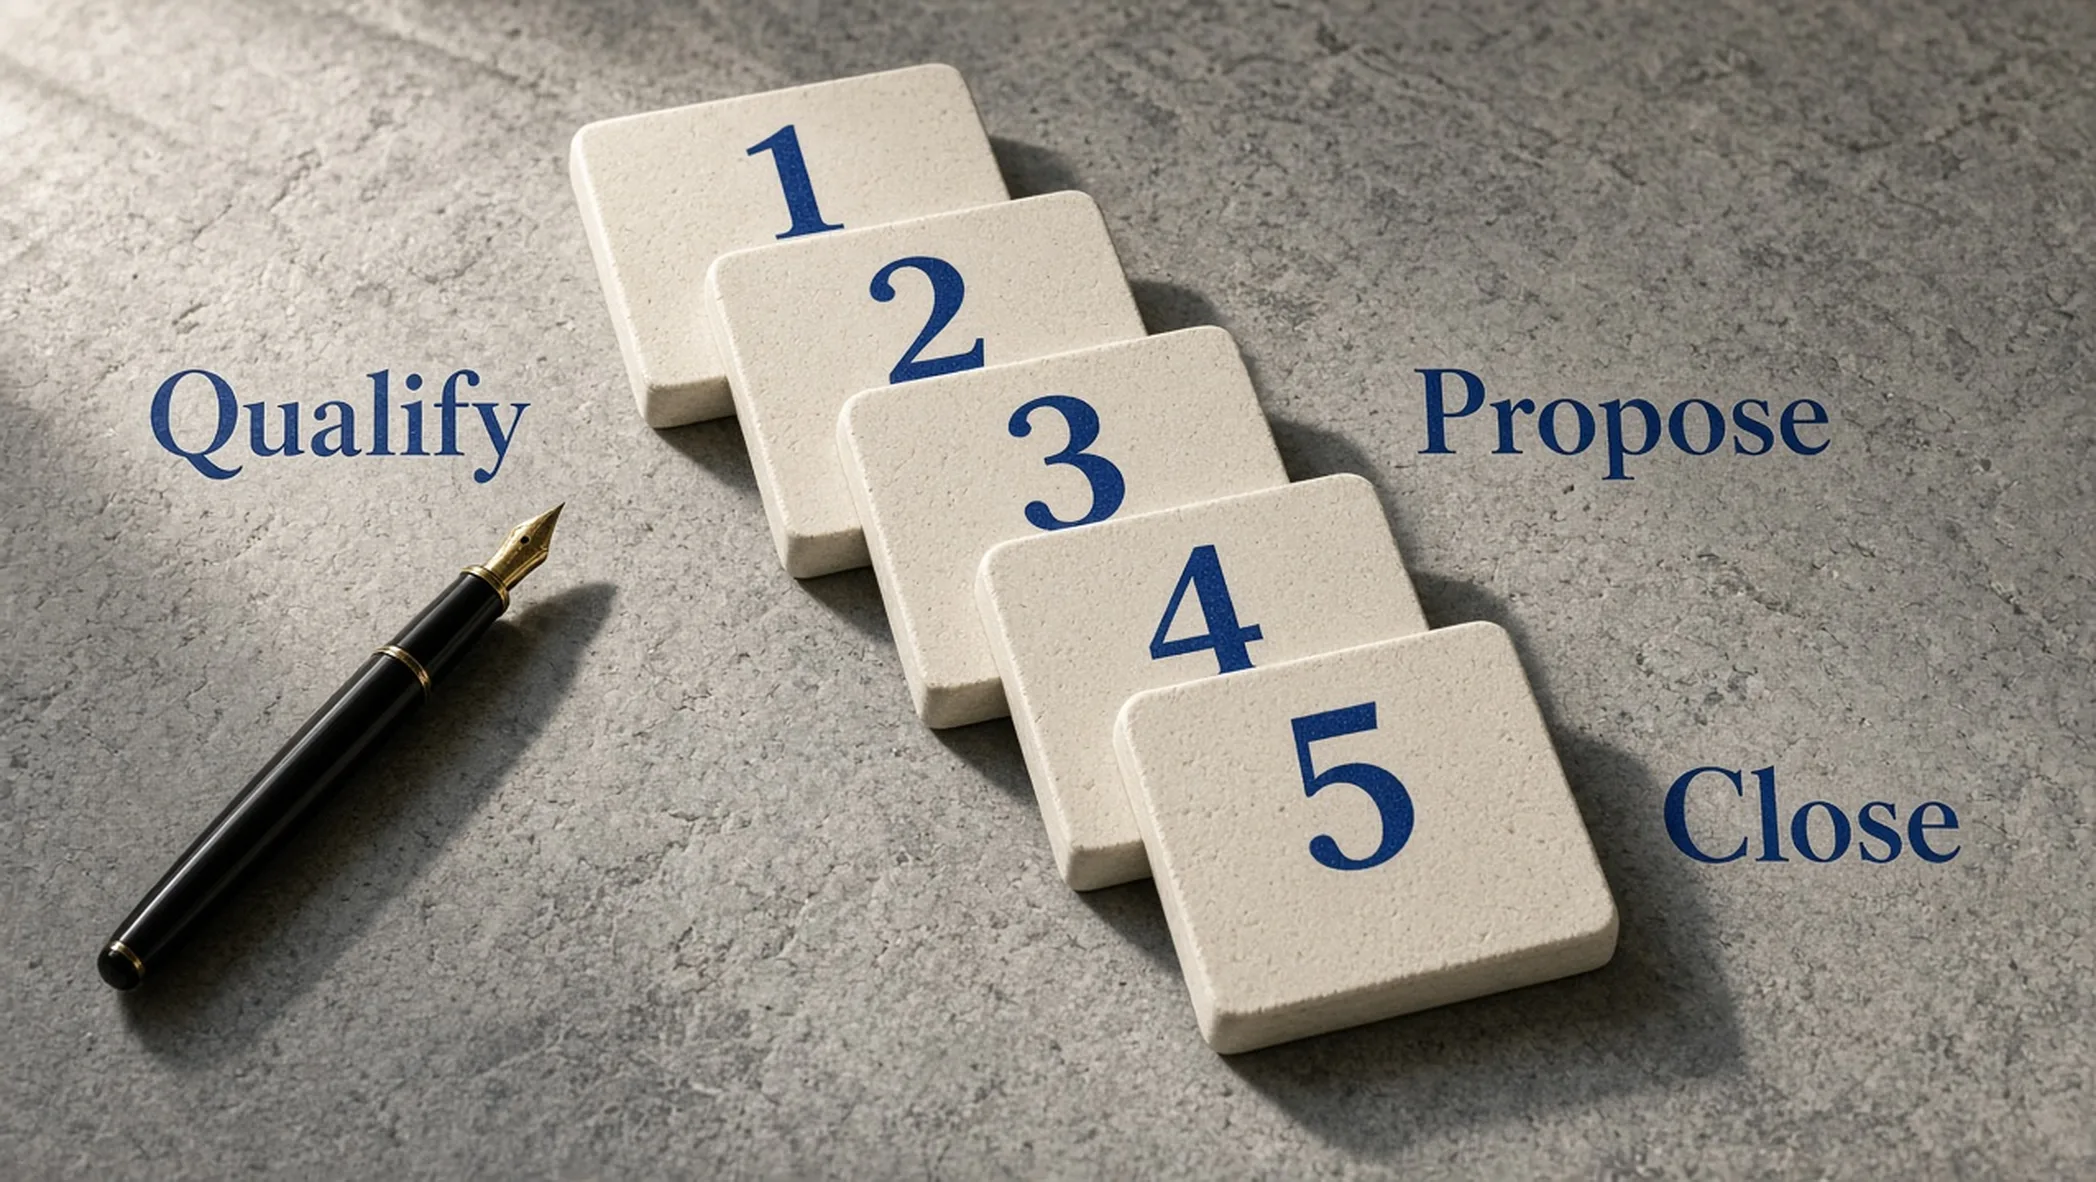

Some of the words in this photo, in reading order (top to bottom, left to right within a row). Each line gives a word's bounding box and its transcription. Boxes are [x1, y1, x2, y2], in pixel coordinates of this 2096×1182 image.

[746, 125, 843, 241] 1
[869, 256, 985, 385] 2
[150, 368, 530, 482] Qualify
[1008, 395, 1126, 531] 3
[1414, 367, 1830, 479] Propose
[1149, 544, 1263, 675] 4
[1291, 701, 1415, 872] 5
[1664, 766, 1960, 864] Close
